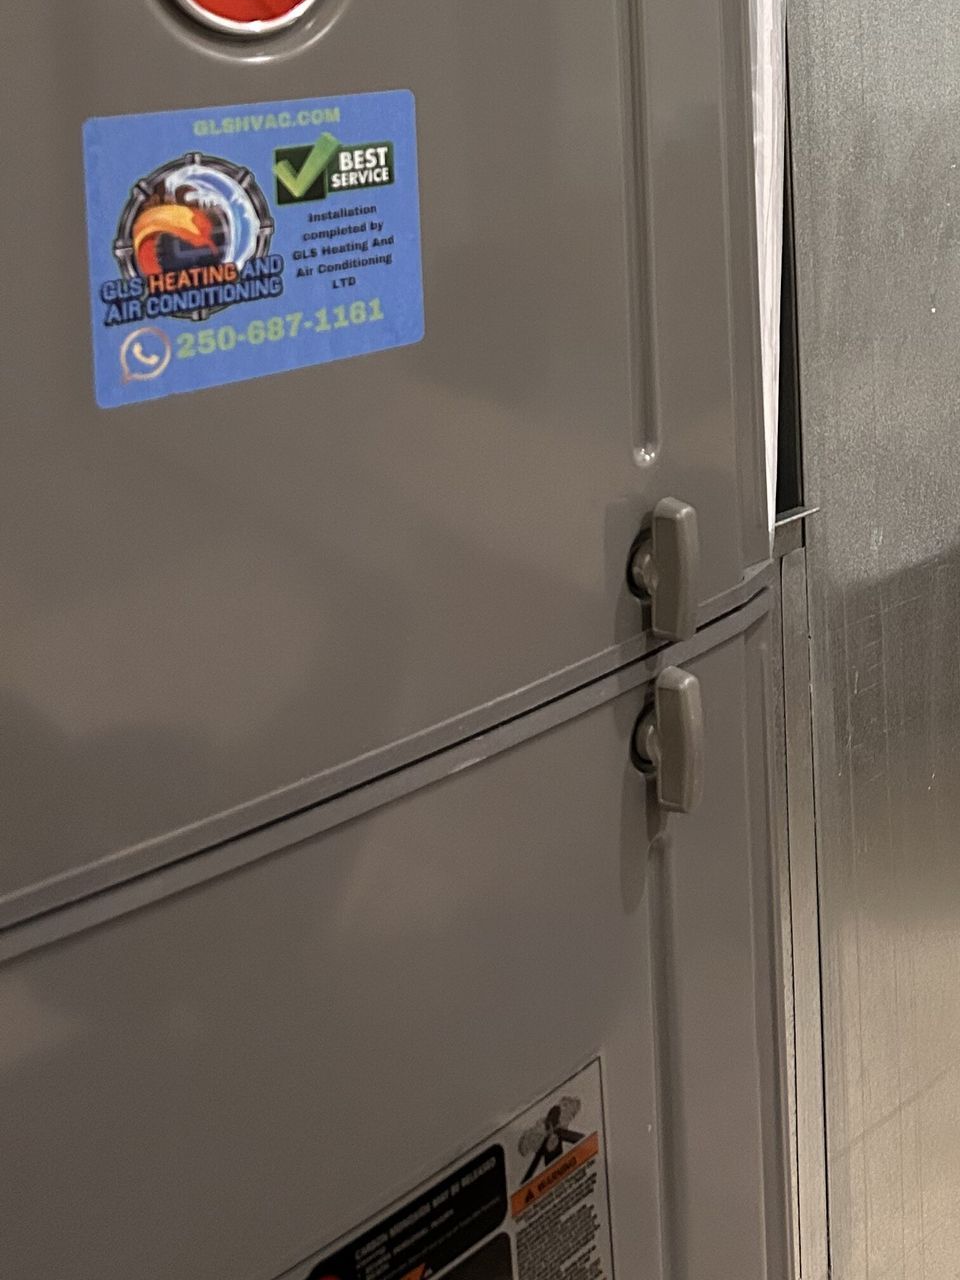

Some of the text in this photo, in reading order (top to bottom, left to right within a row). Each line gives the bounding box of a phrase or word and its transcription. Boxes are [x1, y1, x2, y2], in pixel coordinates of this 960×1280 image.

[193, 108, 340, 136] GLSHVAC.COM
[339, 147, 388, 170] BEST
[331, 168, 390, 189] SERVICE
[309, 205, 377, 222] Installation
[303, 221, 384, 241] completed by
[292, 235, 394, 260] GLS Heating And
[296, 253, 392, 278] Air Conditioning
[101, 255, 285, 301] GLS HEATING AND
[332, 277, 356, 289] LTD
[104, 276, 283, 325] AIR CONDITIONING
